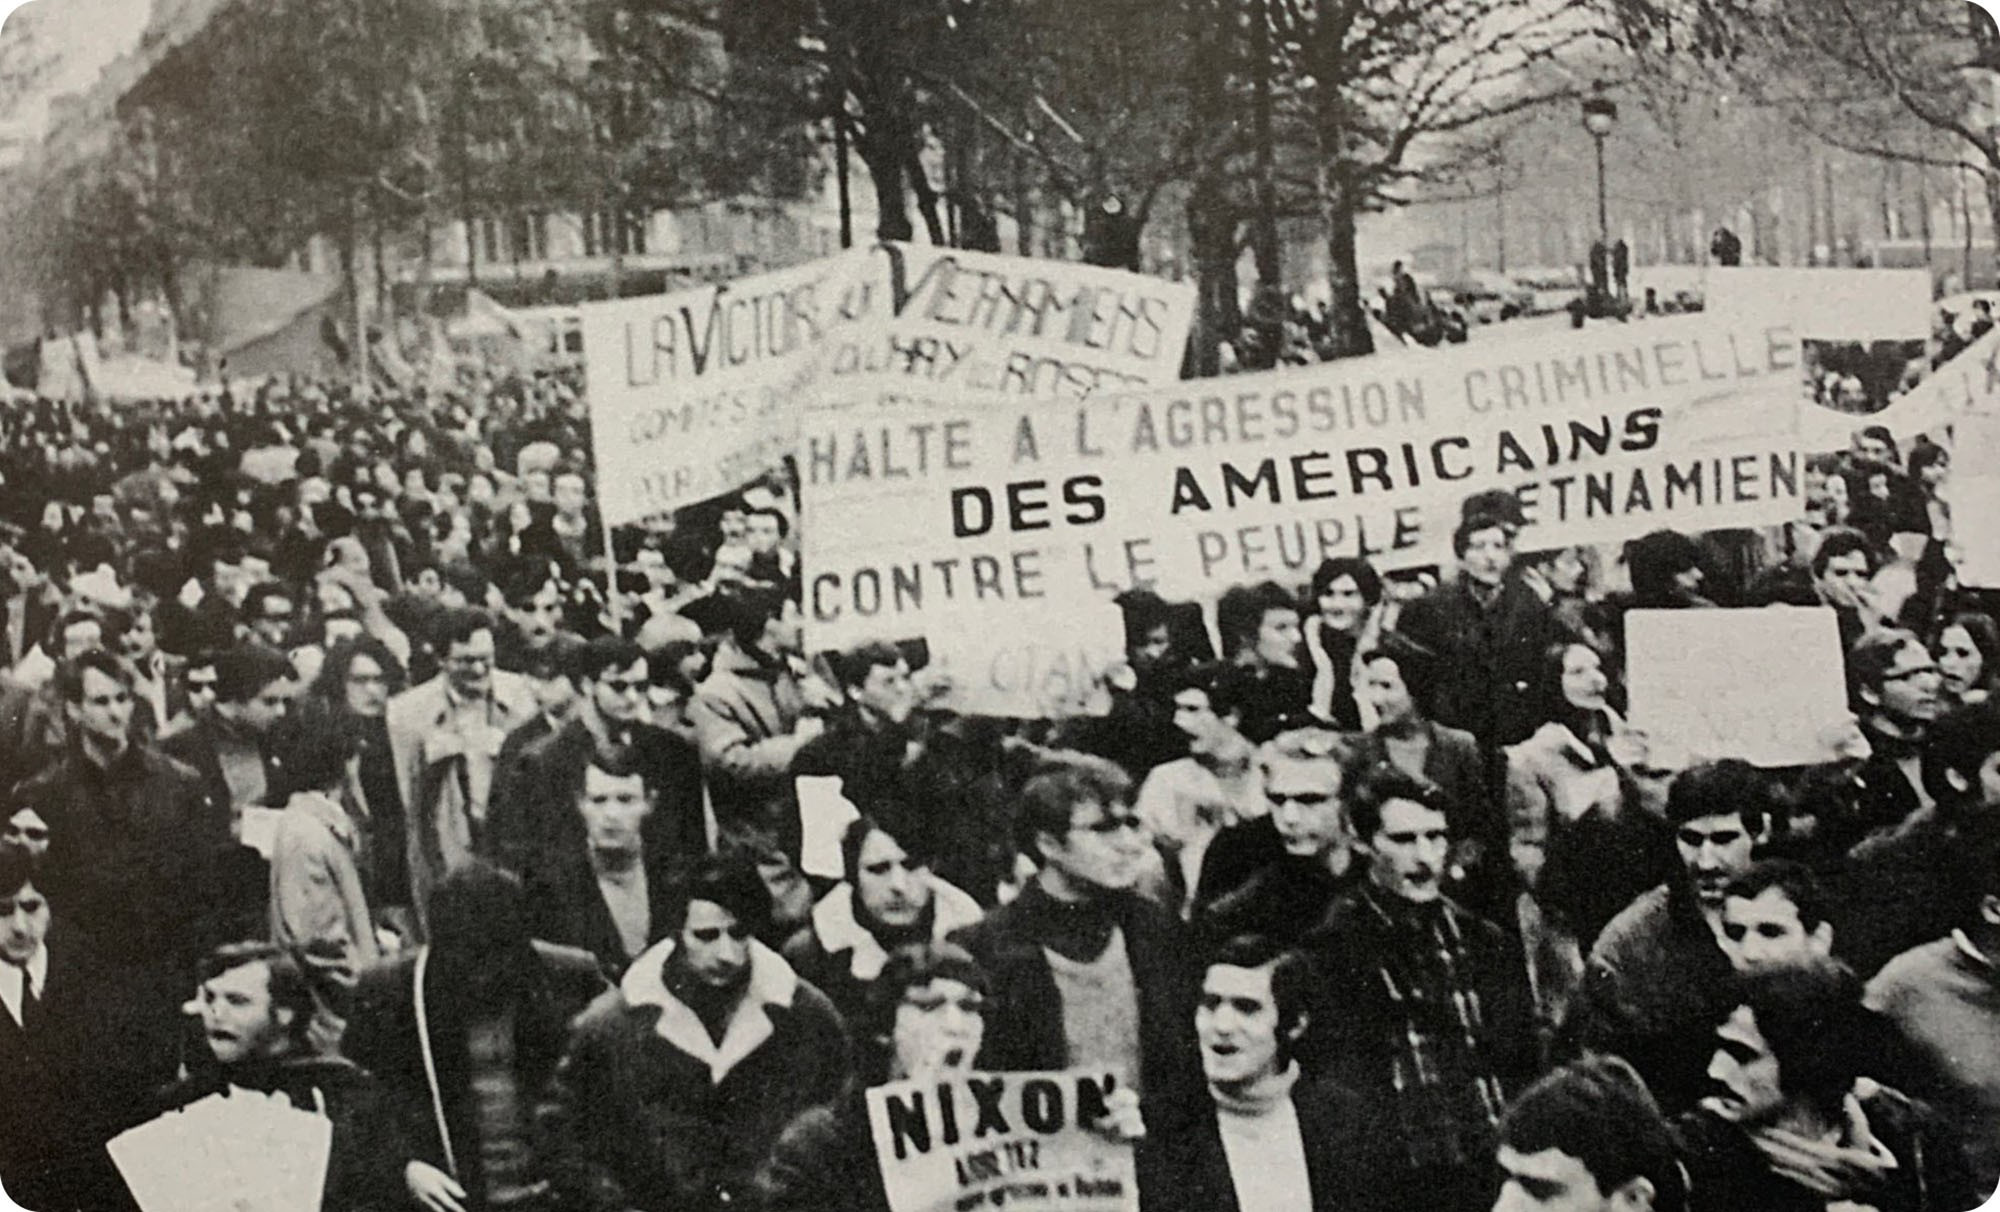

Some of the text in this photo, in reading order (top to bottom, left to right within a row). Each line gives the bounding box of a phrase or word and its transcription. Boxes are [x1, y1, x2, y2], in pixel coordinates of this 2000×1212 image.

[809, 419, 973, 484] HALTE
[1464, 326, 1796, 412] CRIMINELLE
[812, 451, 1799, 622] CONTRE LE PEUPLE ETNAMIEN
[951, 475, 1107, 538] DES
[886, 1073, 1116, 1160] NIXON
